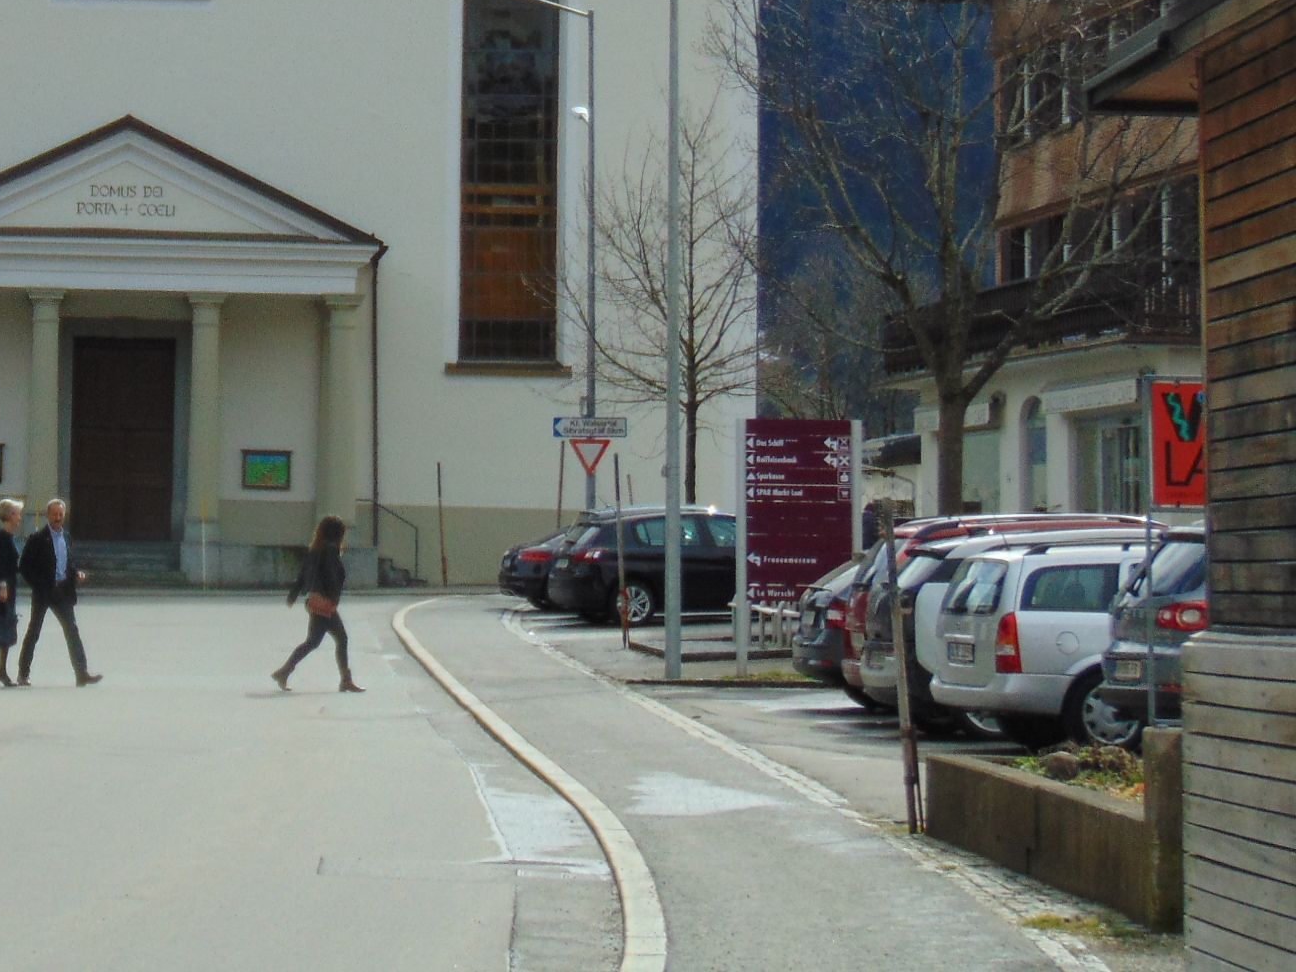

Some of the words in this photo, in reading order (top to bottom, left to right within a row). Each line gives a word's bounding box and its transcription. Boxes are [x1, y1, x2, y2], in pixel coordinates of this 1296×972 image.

[90, 184, 137, 198] DOMUS
[143, 185, 164, 198] DEI
[76, 202, 118, 215] PORTA
[138, 203, 176, 217] COELI
